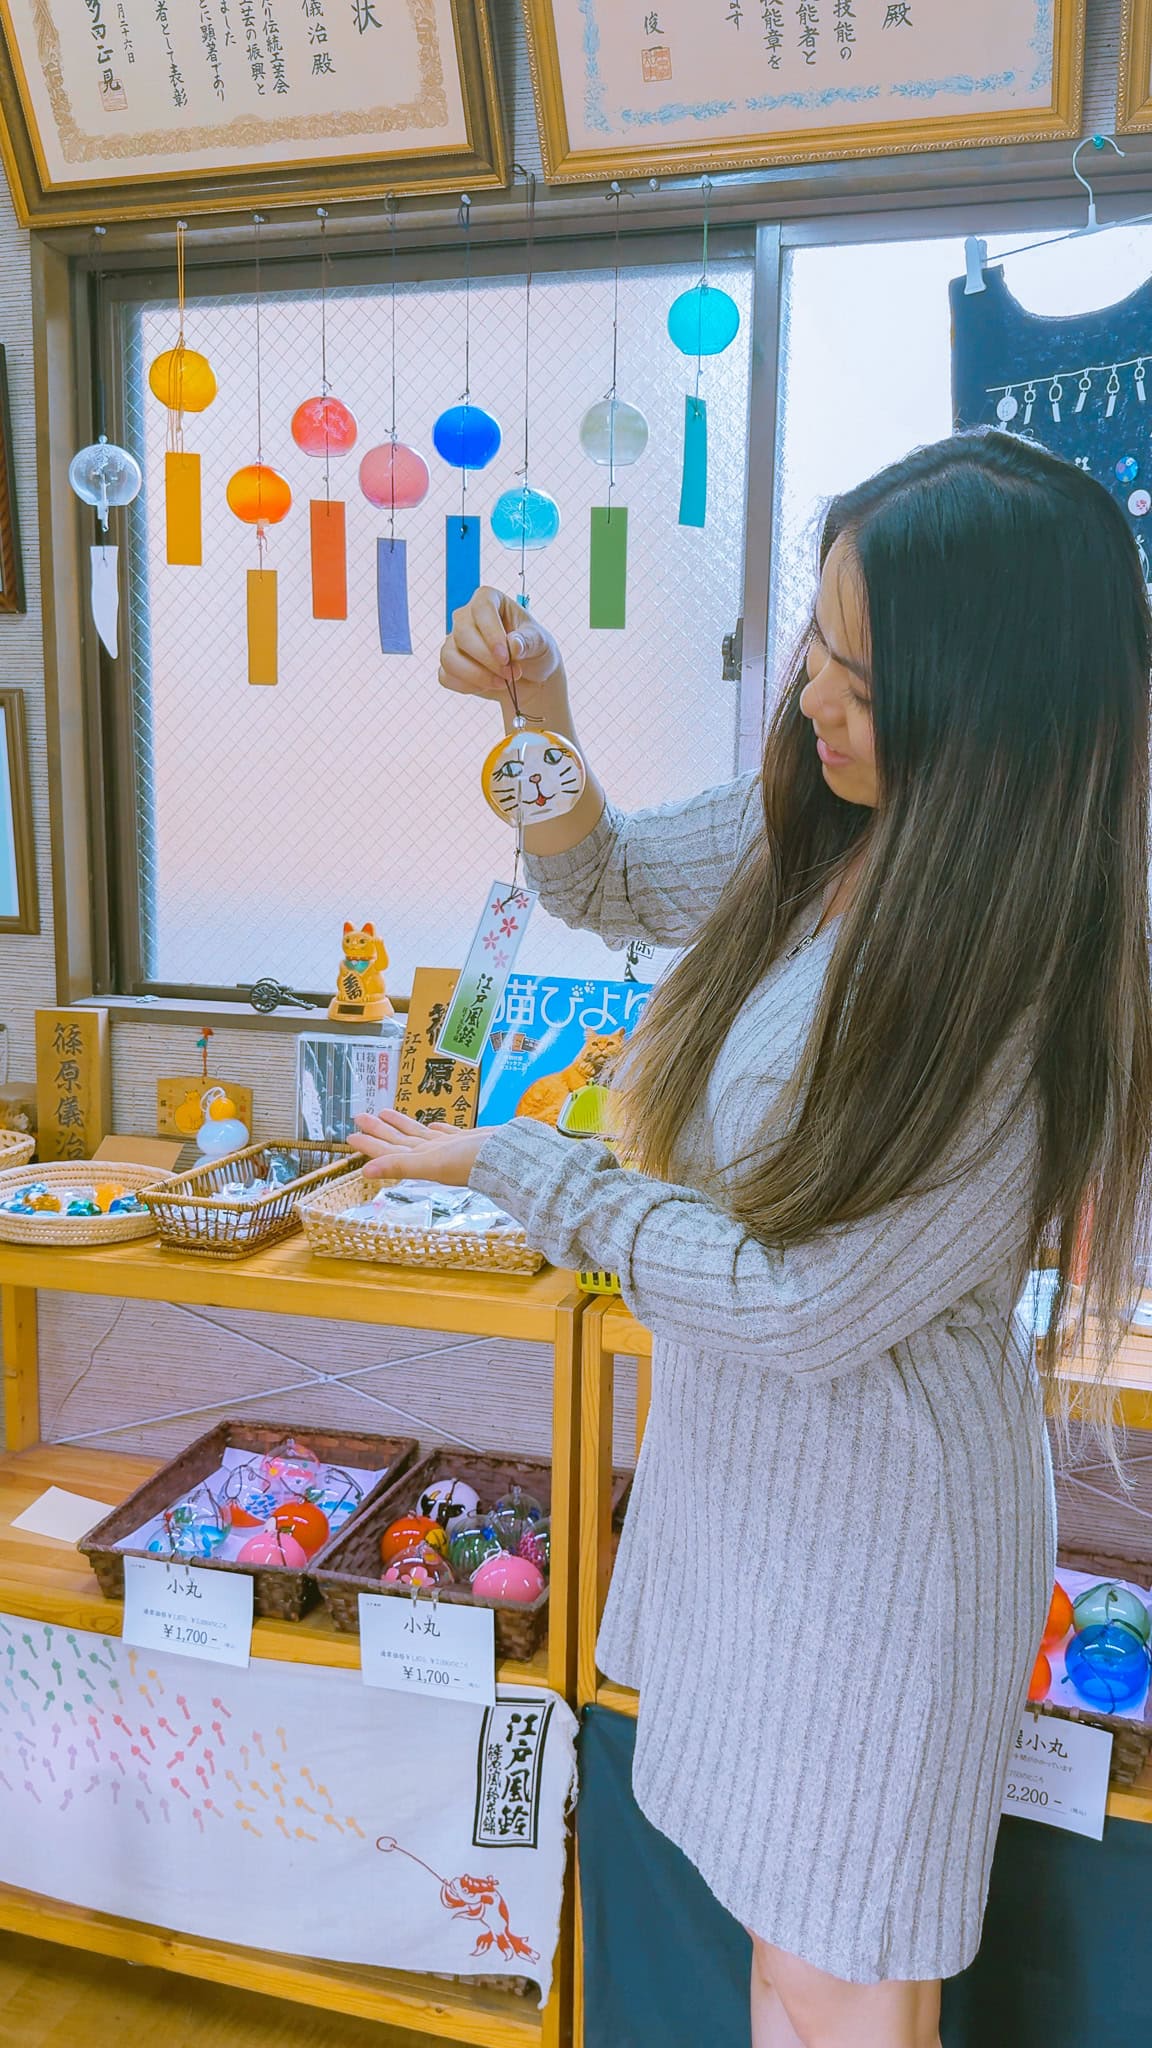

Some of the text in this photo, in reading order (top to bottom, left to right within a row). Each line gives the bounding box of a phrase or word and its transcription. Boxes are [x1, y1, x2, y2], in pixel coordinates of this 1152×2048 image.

[117, 3, 135, 63] 月二十六日
[302, 0, 336, 75] 儀治殿
[761, 0, 785, 70] 能章を
[882, 2, 913, 30] 殿
[166, 1579, 202, 1599] 小丸
[403, 1616, 441, 1637] 小丸
[498, 1713, 538, 1836] 江戸風鈴
